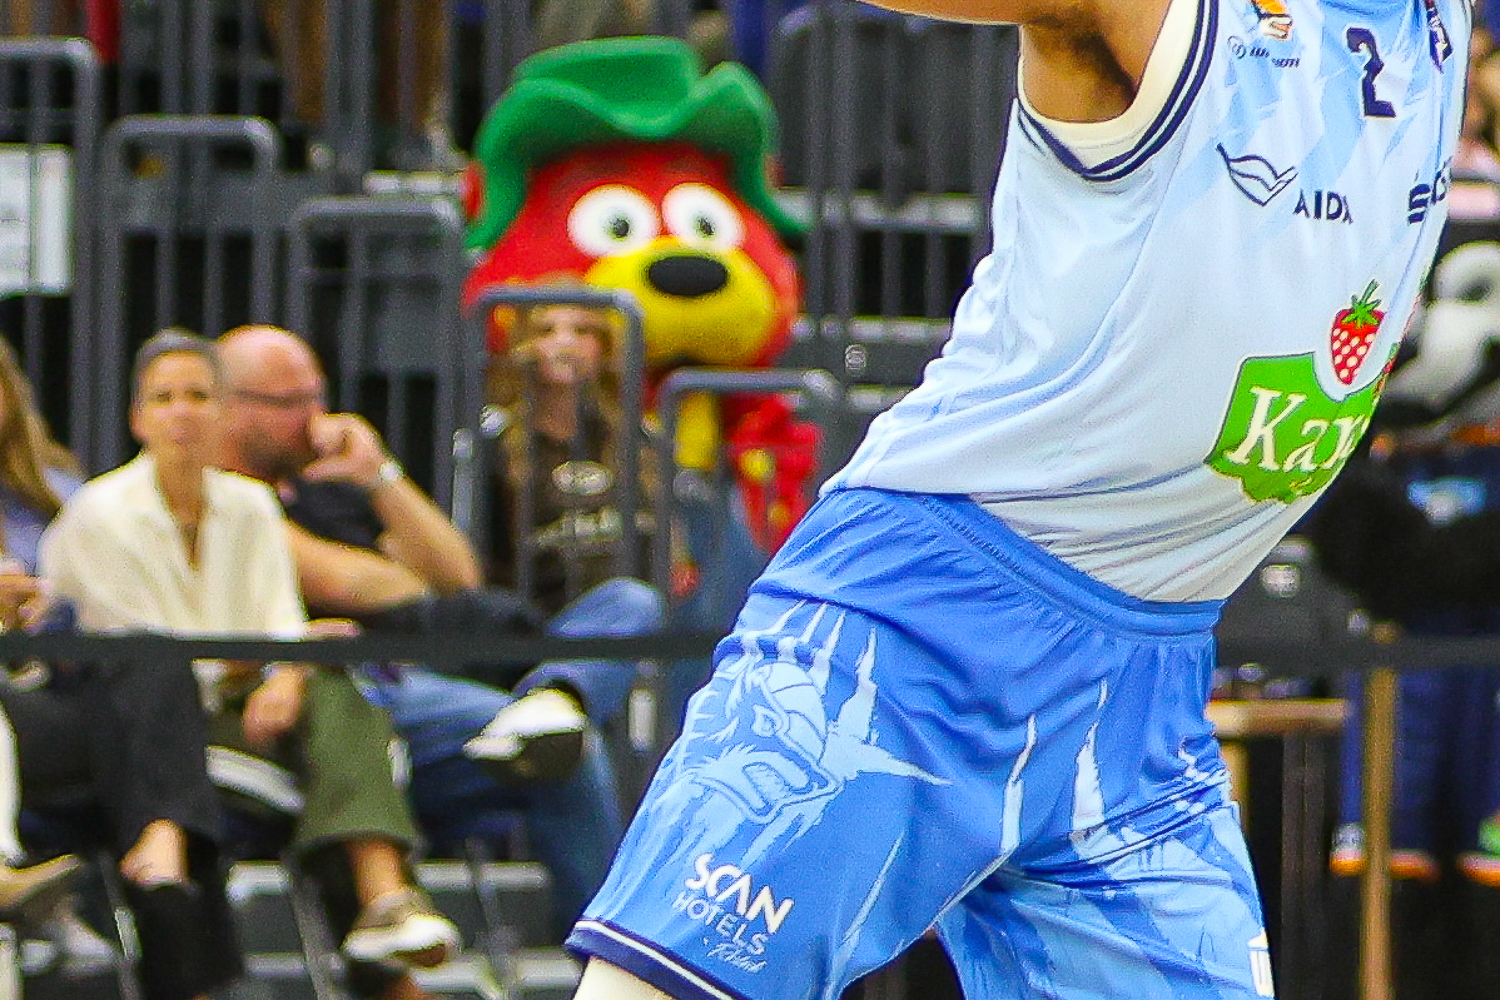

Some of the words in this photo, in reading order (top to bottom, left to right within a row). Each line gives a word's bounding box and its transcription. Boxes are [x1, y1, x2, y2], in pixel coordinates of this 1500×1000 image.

[1345, 26, 1397, 118] 2
[671, 891, 770, 956] HOTELS
[684, 852, 796, 935] SCAN
